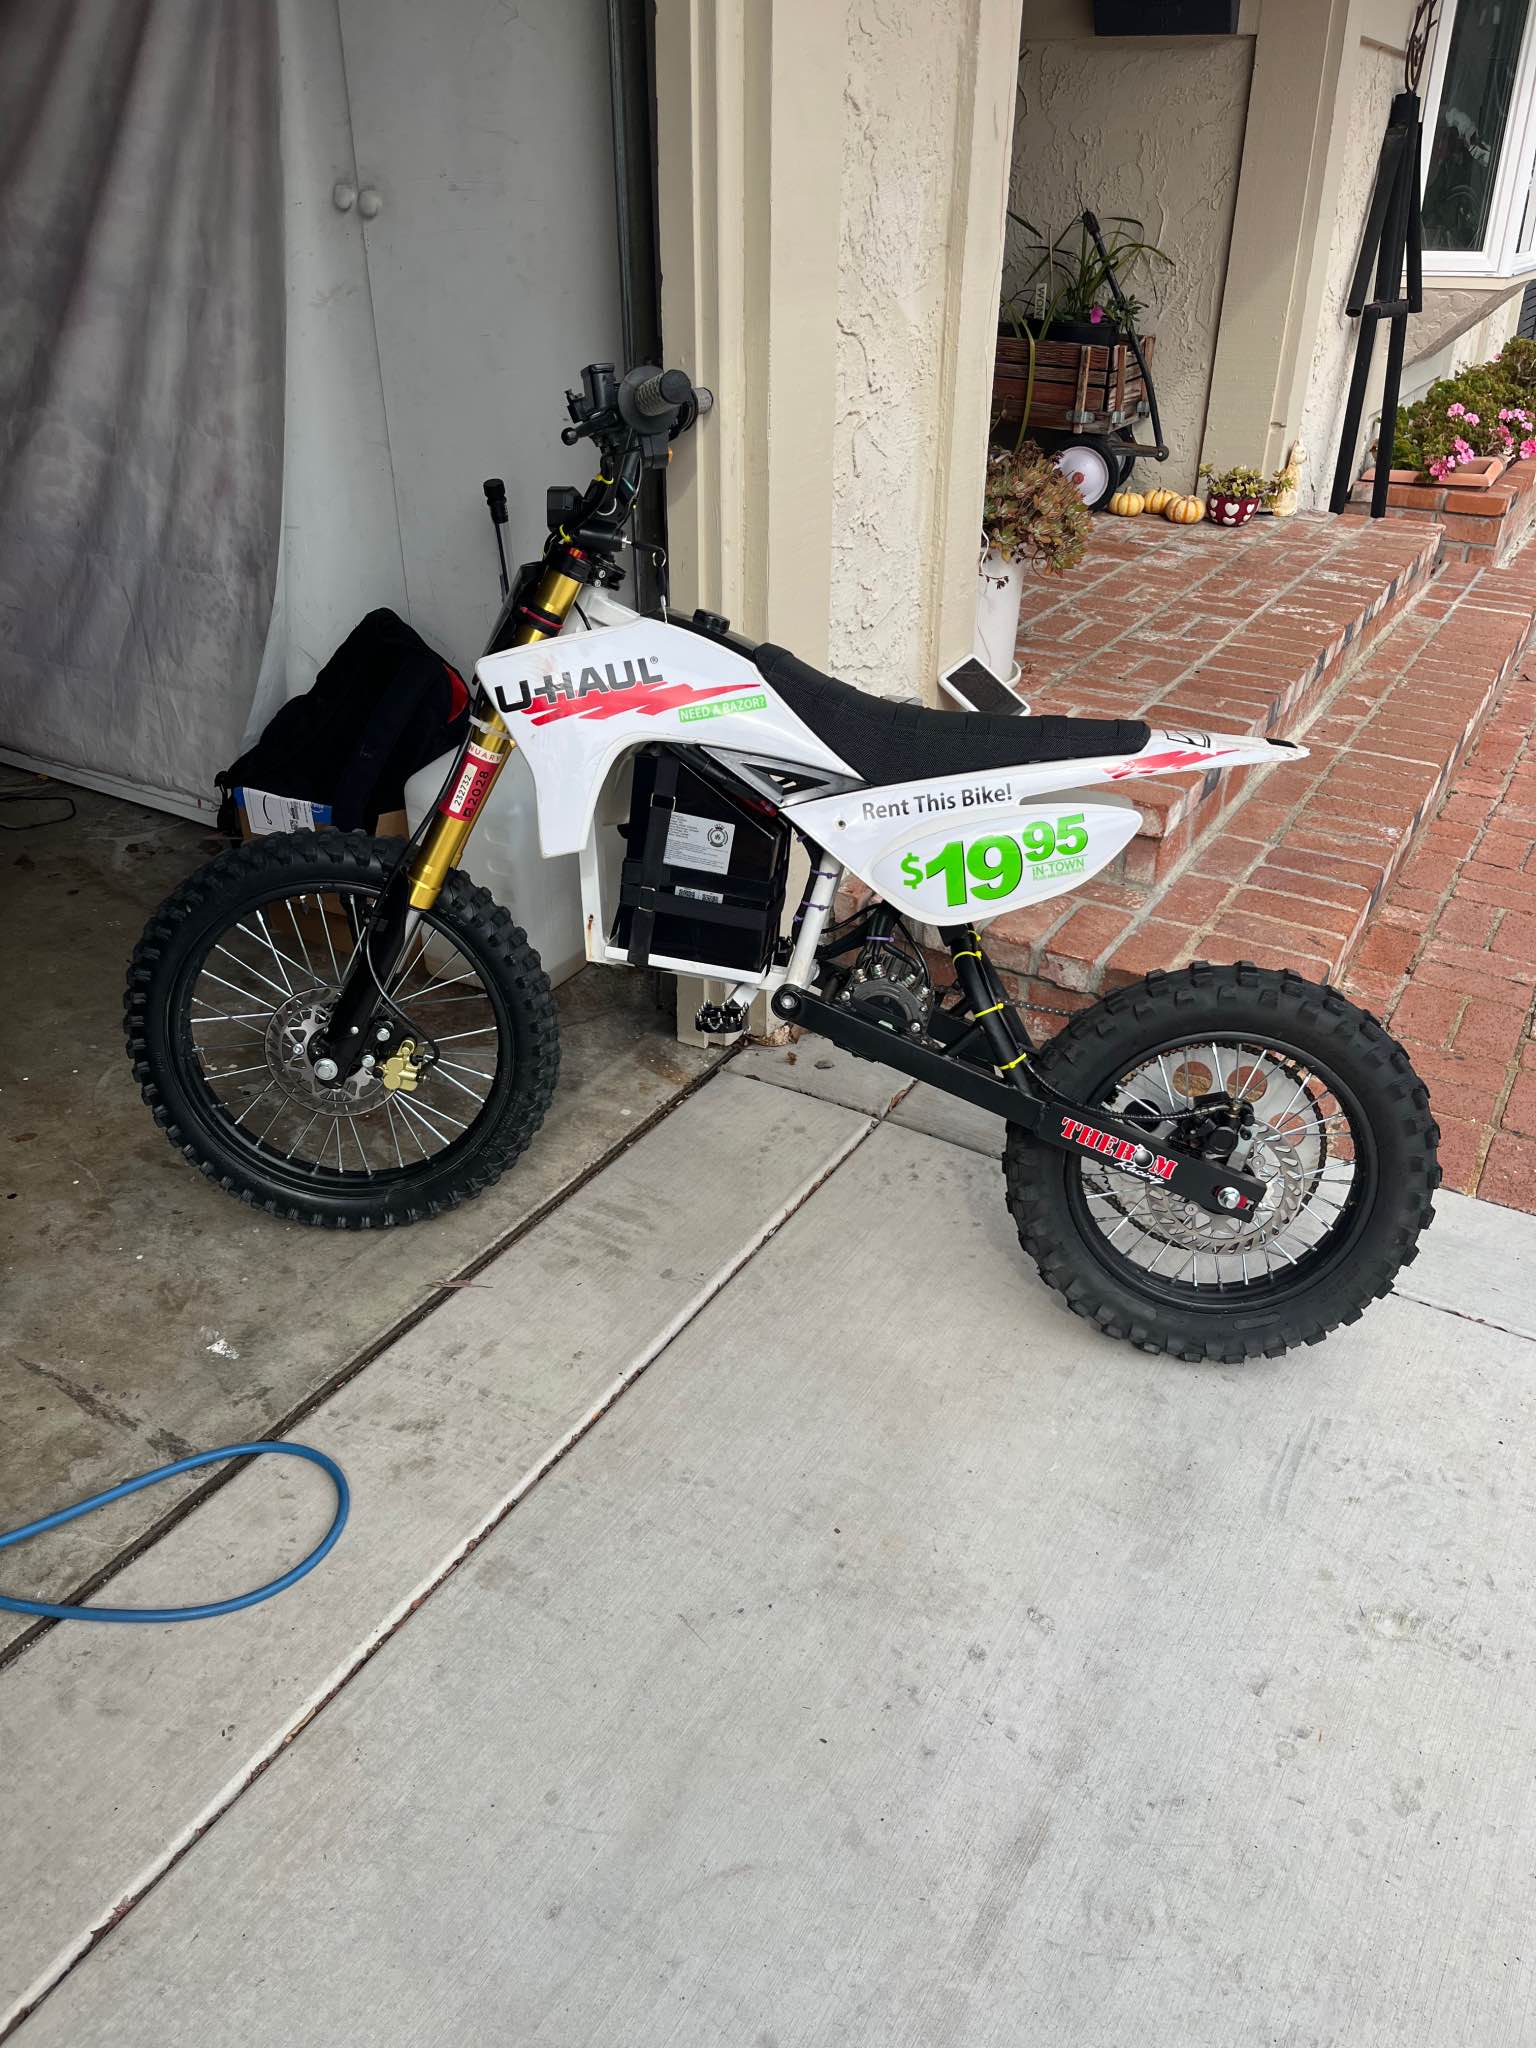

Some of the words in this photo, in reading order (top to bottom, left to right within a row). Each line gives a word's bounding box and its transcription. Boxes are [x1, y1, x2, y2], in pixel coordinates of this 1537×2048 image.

[680, 707, 710, 720] NEED
[712, 705, 721, 715] A
[454, 774, 472, 806] 232732
[862, 801, 910, 821] Rent
[913, 793, 957, 813] This
[961, 783, 1013, 808] Bike!
[1032, 857, 1086, 878] IN-TOWN
